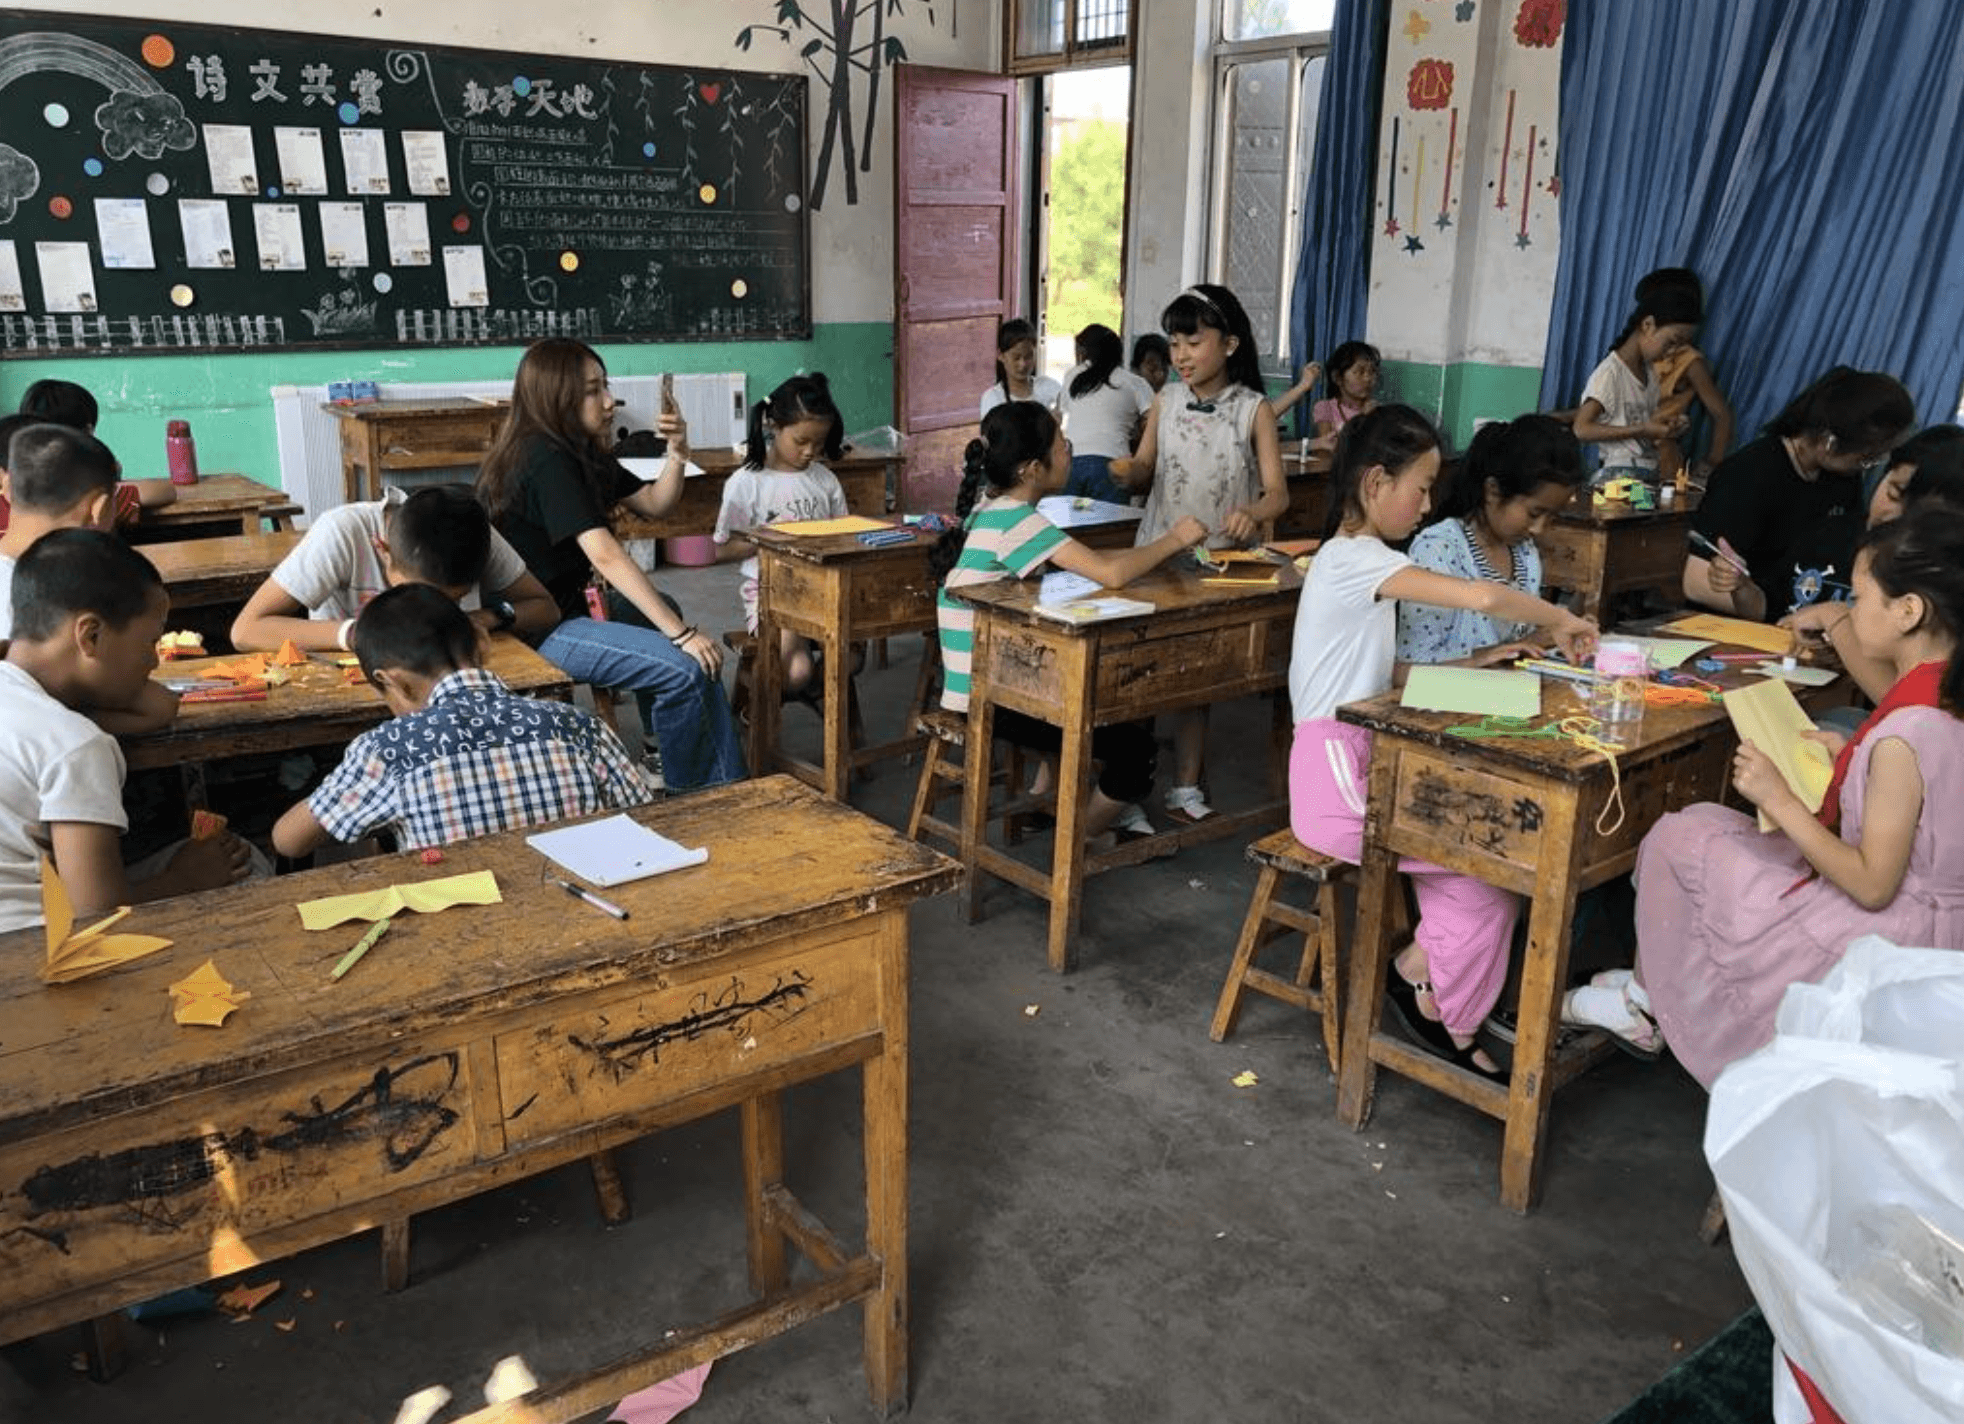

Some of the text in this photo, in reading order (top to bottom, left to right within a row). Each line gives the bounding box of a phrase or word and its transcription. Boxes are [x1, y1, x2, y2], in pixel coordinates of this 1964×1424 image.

[186, 54, 384, 115] 诗文共赏
[462, 78, 599, 120] 数学天地
